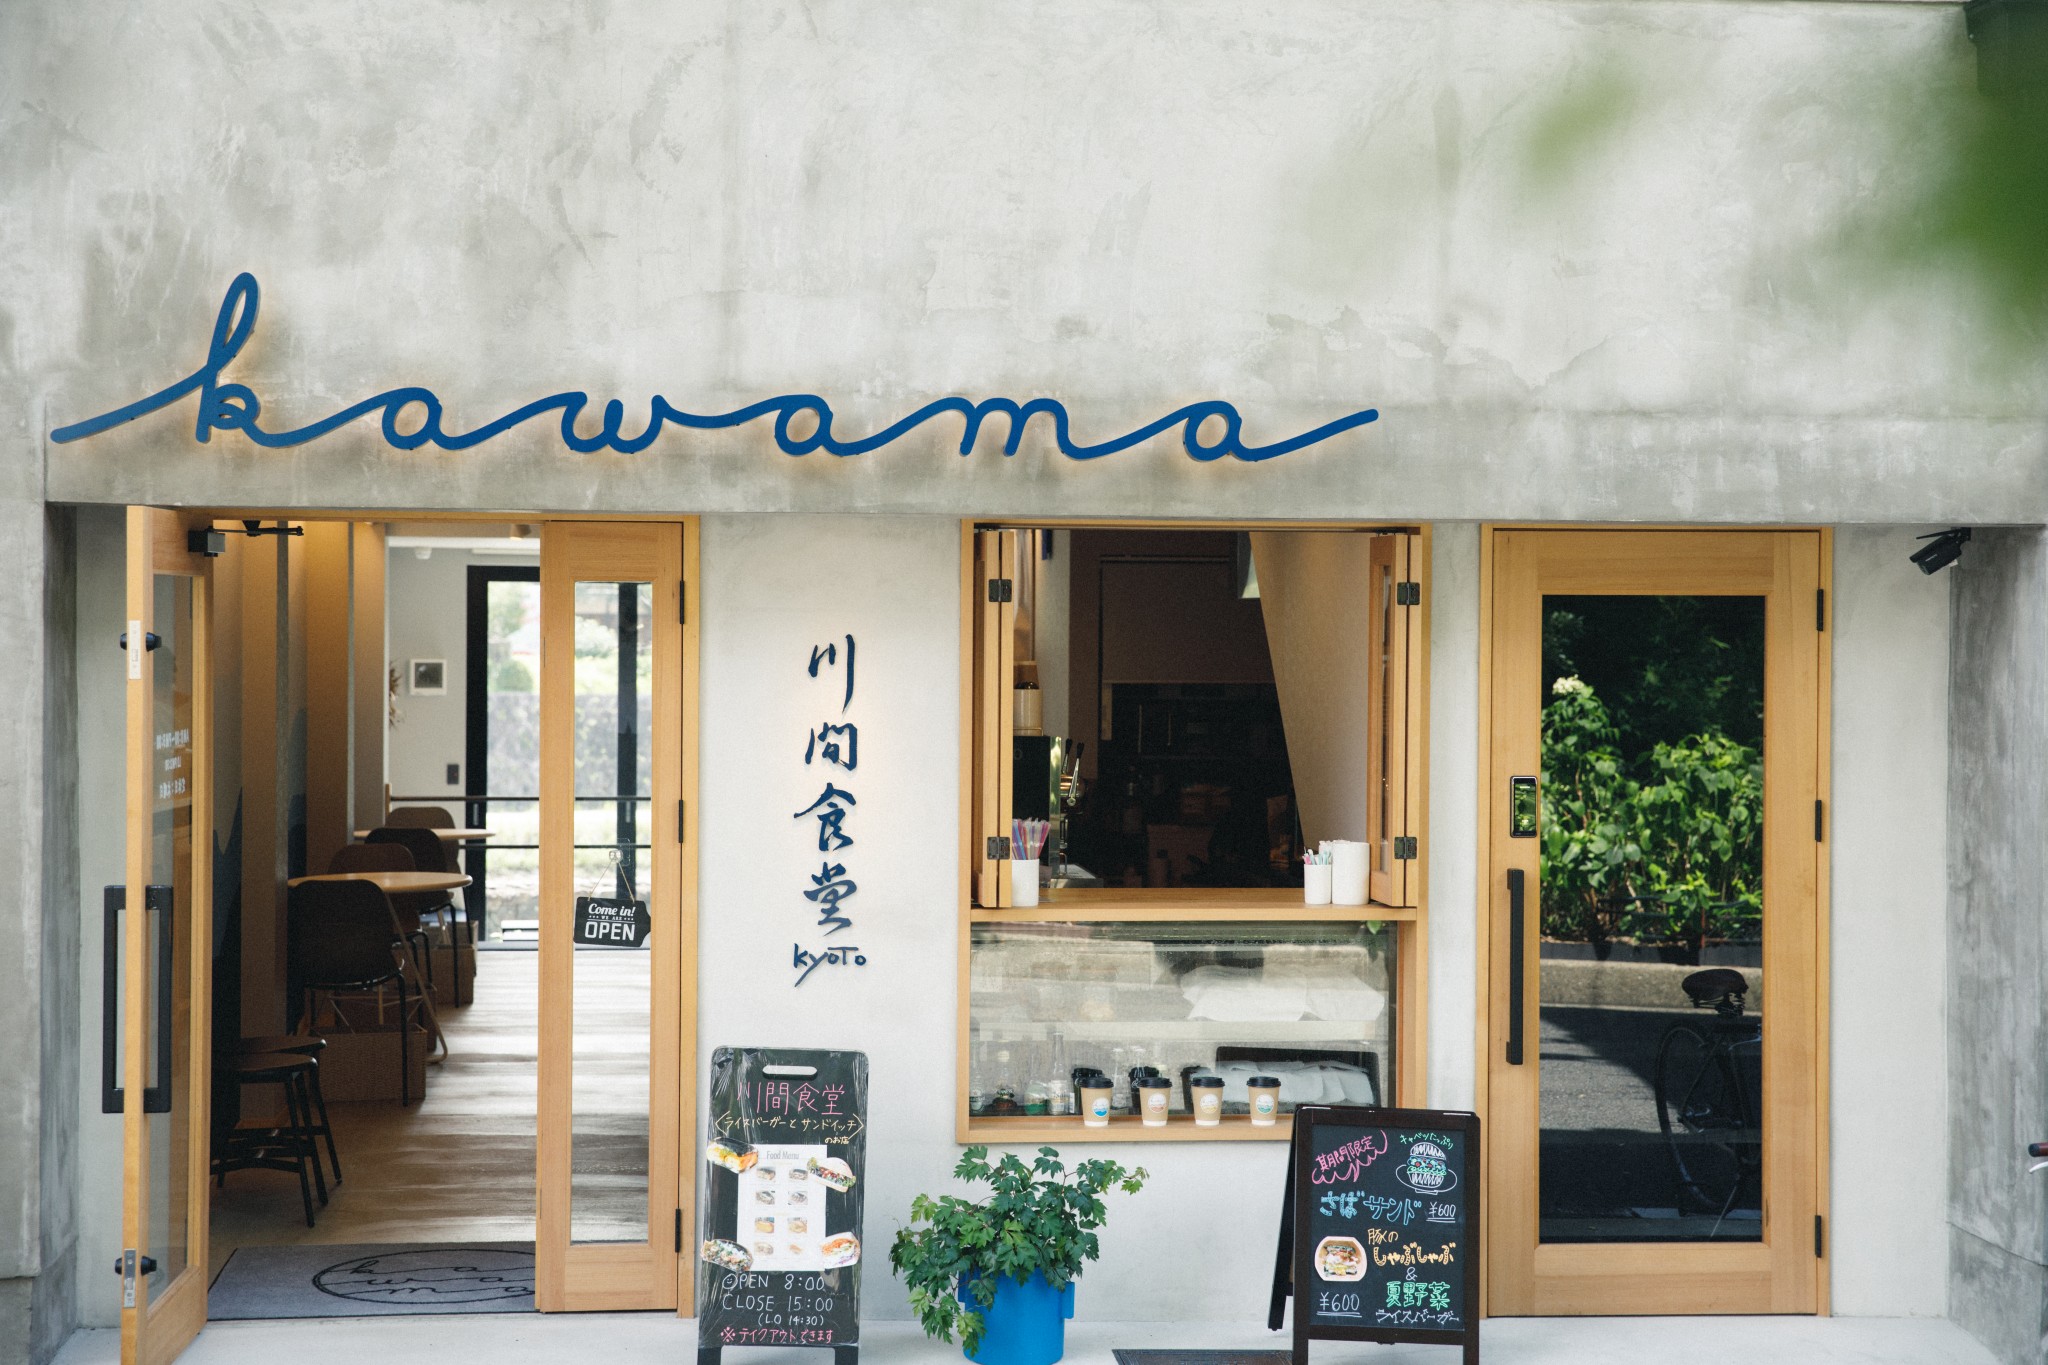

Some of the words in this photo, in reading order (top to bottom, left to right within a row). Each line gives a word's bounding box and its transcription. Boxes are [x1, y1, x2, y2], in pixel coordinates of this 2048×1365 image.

[51, 272, 1379, 462] kawama
[793, 634, 858, 936] 川間食堂
[588, 903, 618, 916] Come
[620, 906, 636, 917] in!
[584, 921, 635, 941] OPEN
[737, 1082, 845, 1115] 川間食堂
[1315, 1134, 1376, 1171] 期間限定
[1428, 1201, 1456, 1218] ¥600
[1367, 1228, 1399, 1245] 豚の
[1373, 1242, 1456, 1266] しゃぶしゃぶ
[722, 1273, 769, 1290] OPEN
[784, 1273, 825, 1291] 8:00
[1405, 1267, 1417, 1281] &
[722, 1292, 775, 1312] CLOSE
[788, 1295, 833, 1312] 15:00
[1319, 1292, 1360, 1311] ¥600
[1386, 1280, 1450, 1311] 夏野菜
[1376, 1308, 1460, 1324] ライスバーガー
